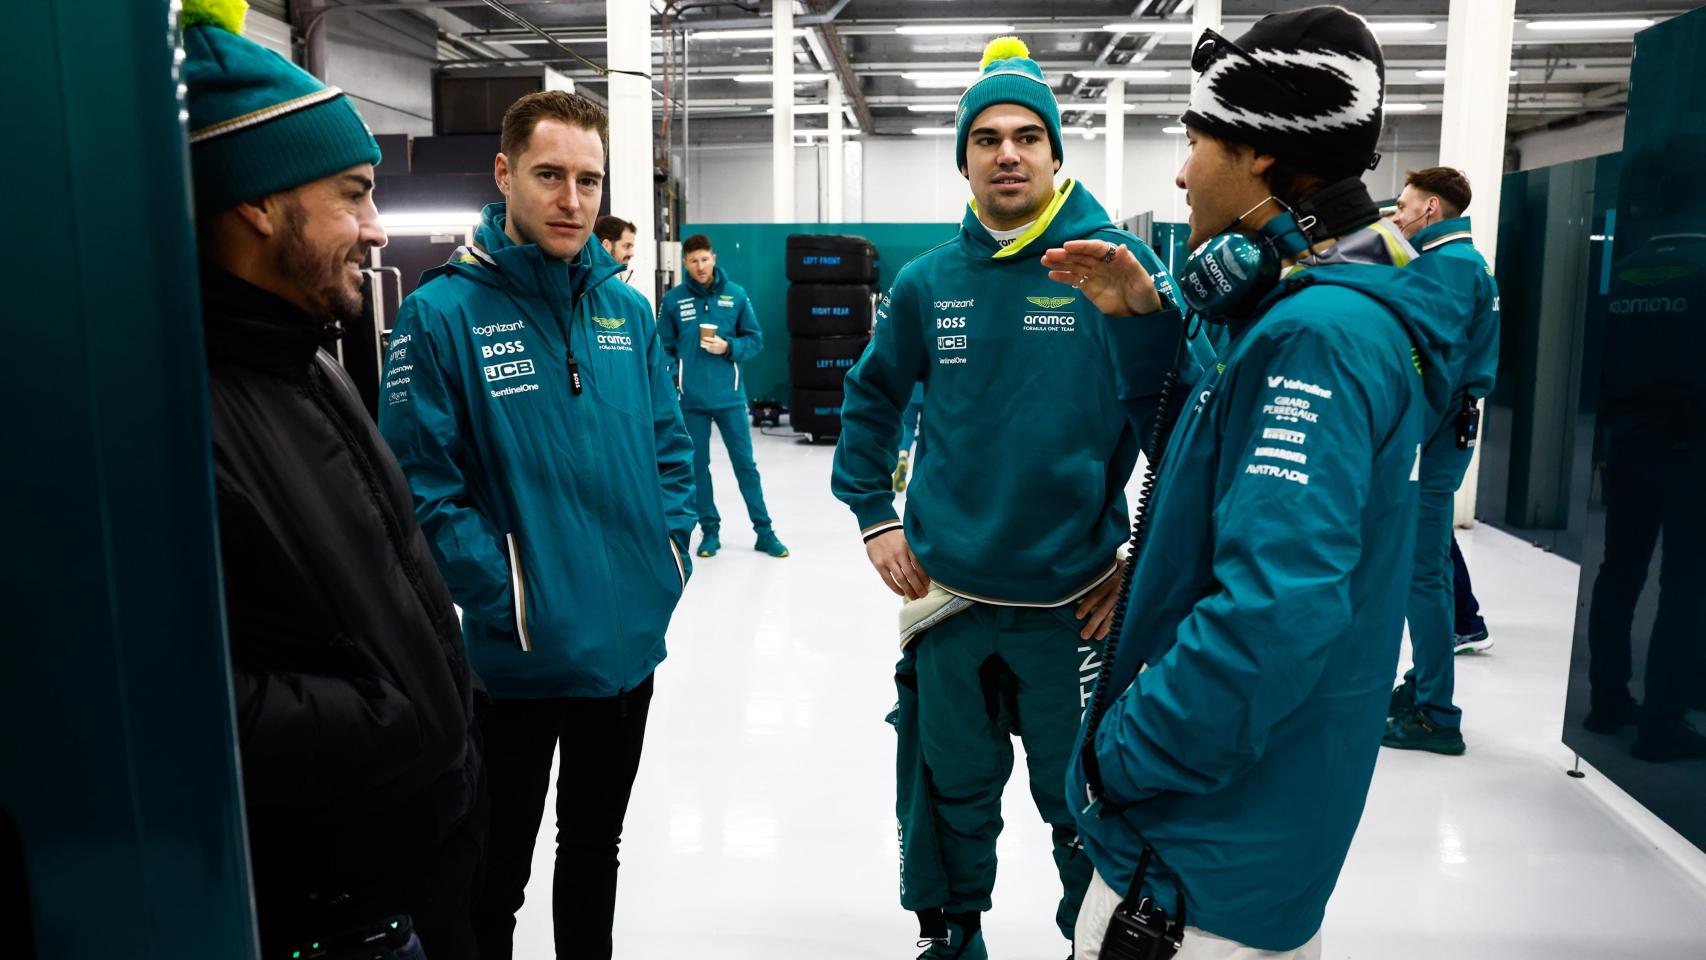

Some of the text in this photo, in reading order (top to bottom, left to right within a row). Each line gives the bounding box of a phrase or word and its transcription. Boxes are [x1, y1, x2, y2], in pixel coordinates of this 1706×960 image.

[998, 238, 1016, 247] ram
[803, 256, 841, 265] LEFT FRONT
[1205, 252, 1232, 293] aramco
[1188, 272, 1208, 298] EPOS
[811, 307, 849, 316] RIGHT REAR
[937, 317, 966, 329] BOSS
[1023, 315, 1075, 326] aramco
[473, 320, 525, 337] cognizant
[597, 335, 631, 346] aramco
[938, 336, 966, 349] JCB
[482, 341, 524, 358] BOSS
[816, 359, 853, 368] LEFT REAR
[485, 360, 533, 381] JCB
[491, 384, 539, 397] SentinelOne
[1284, 379, 1332, 399] Valvoline
[1274, 396, 1310, 409] GIRARD
[1263, 405, 1318, 423] PERREGAUX
